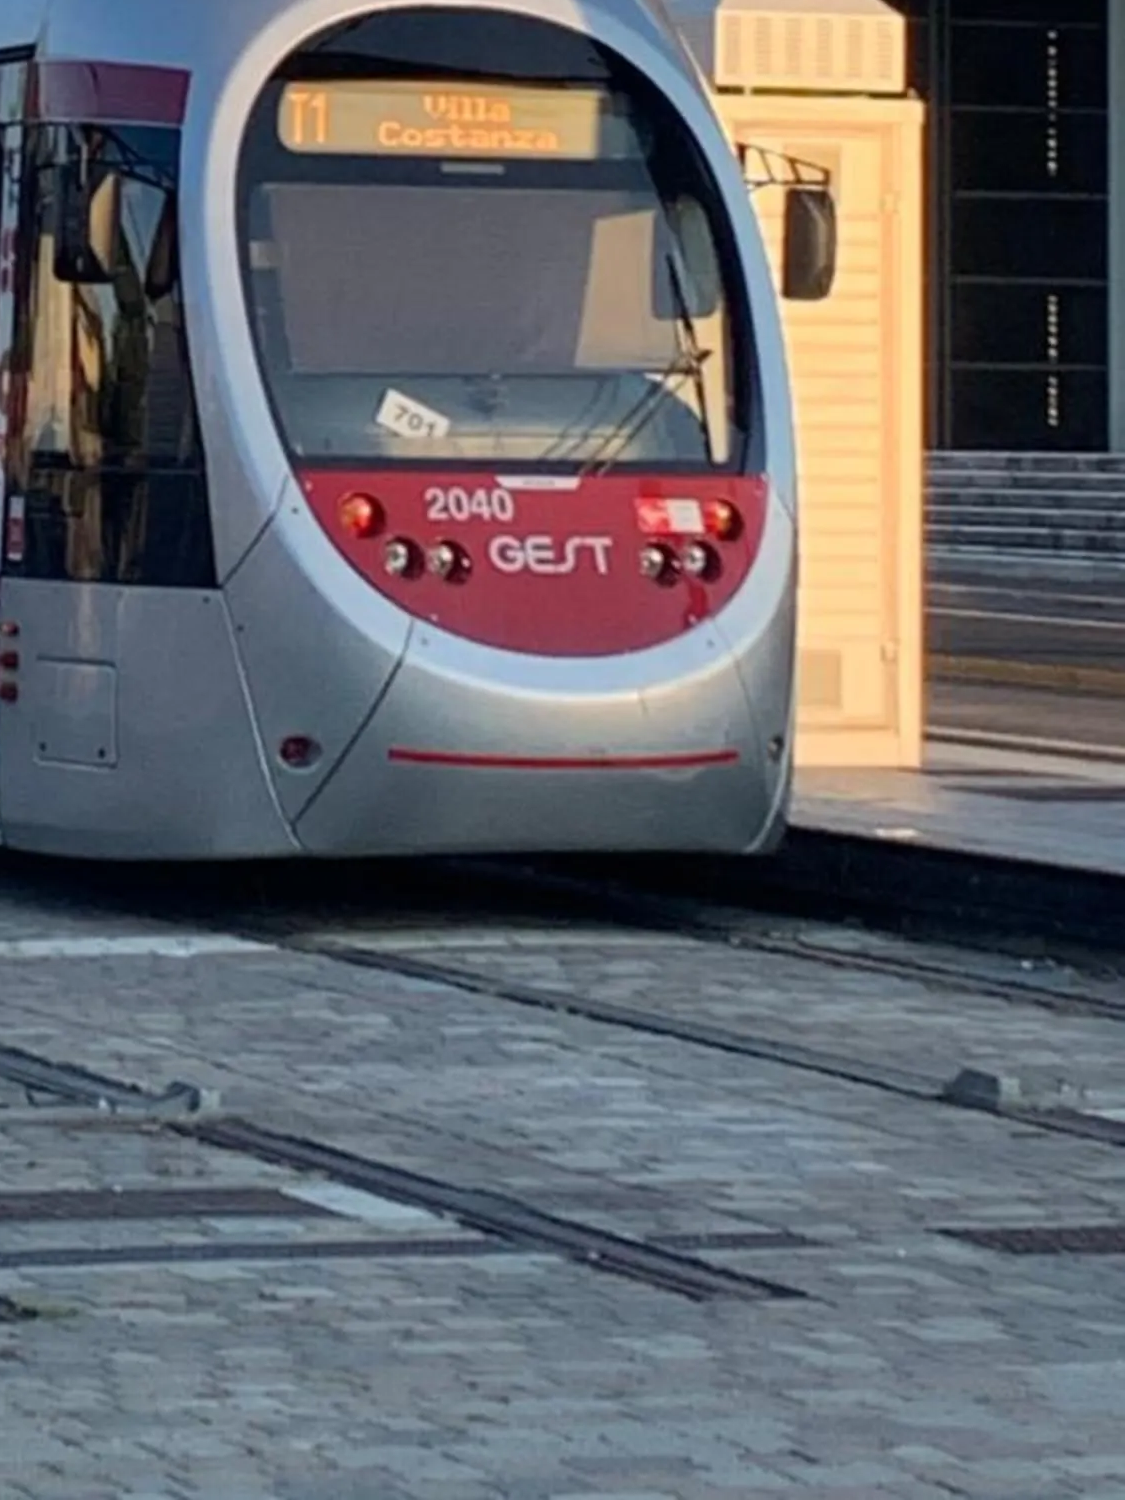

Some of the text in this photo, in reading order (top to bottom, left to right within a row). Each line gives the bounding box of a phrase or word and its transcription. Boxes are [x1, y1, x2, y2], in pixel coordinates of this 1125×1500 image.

[288, 91, 328, 144] T1
[424, 94, 511, 122] Villa
[378, 121, 558, 149] Costanza
[425, 486, 514, 522] 2040
[489, 535, 613, 575] GEST
